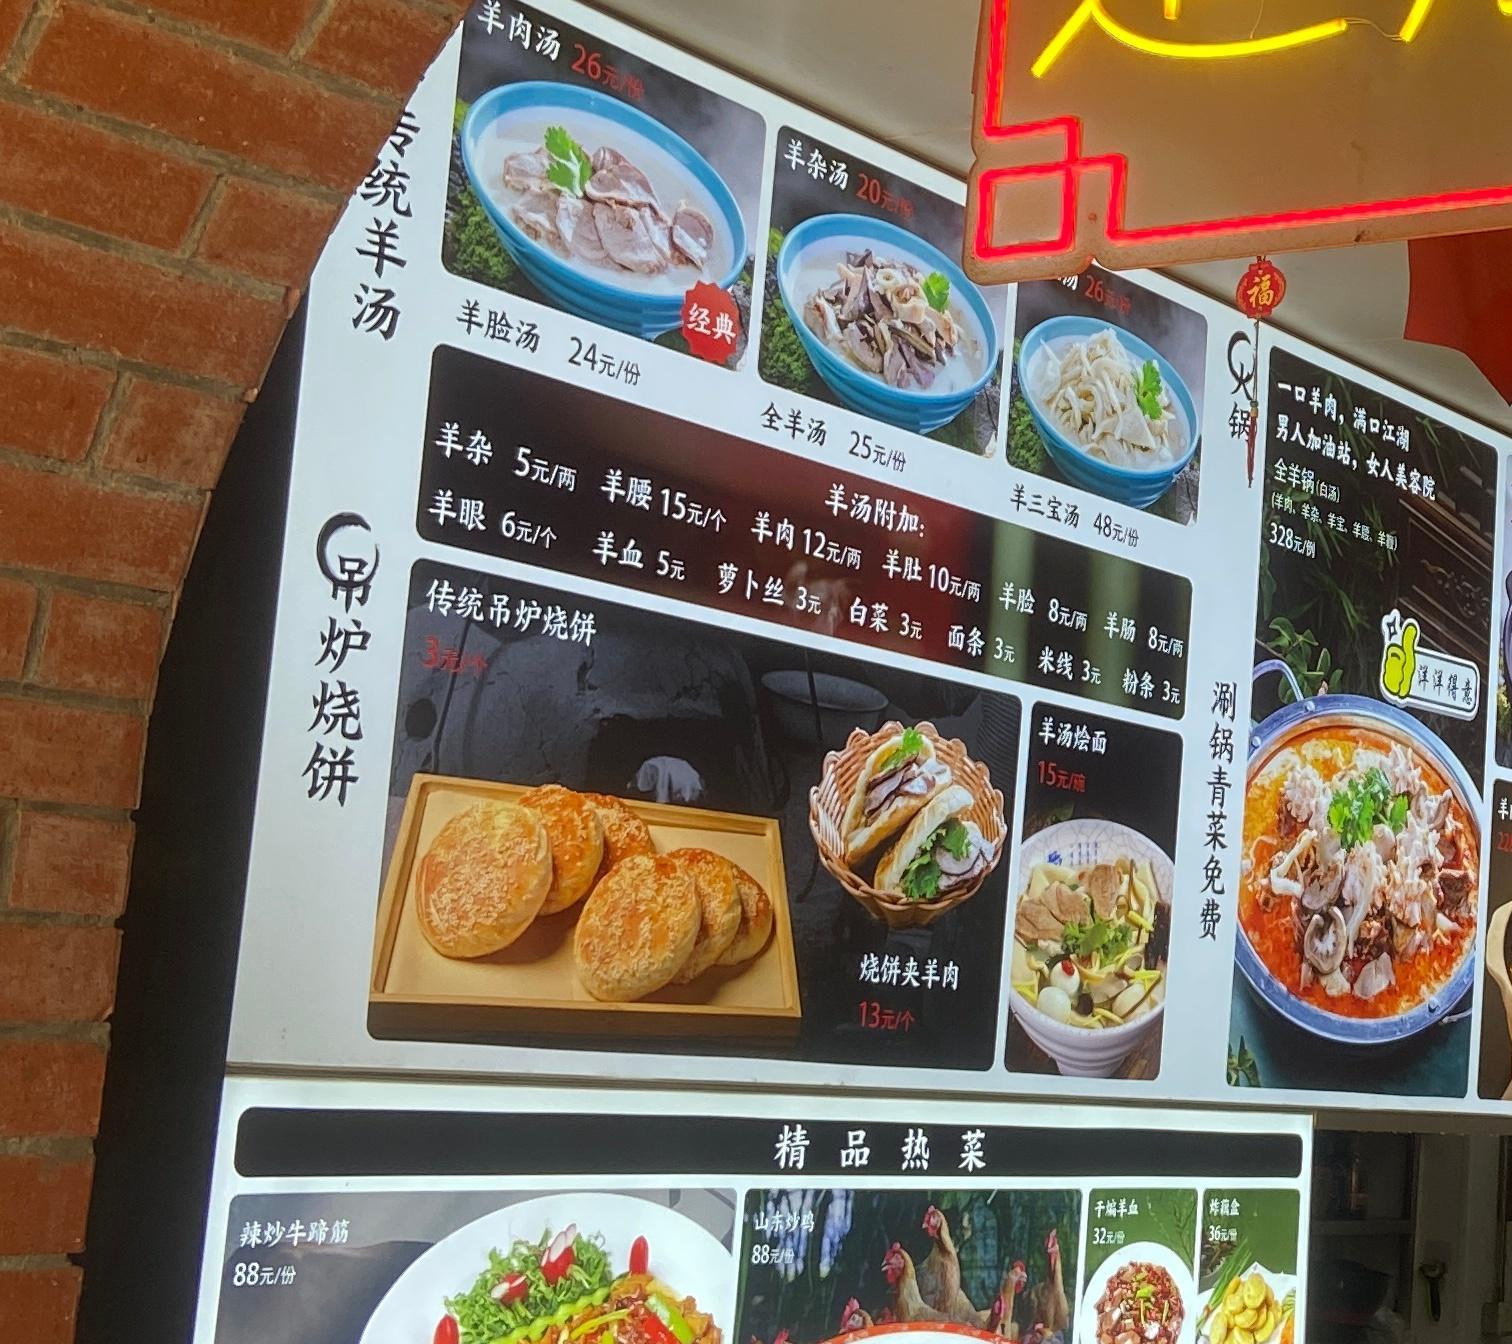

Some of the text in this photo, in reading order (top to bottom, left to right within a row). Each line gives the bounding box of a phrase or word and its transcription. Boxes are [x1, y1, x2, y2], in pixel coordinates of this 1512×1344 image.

[478, 0, 561, 61] 羊肉汤
[784, 140, 849, 191] 羊杂汤
[1247, 274, 1274, 307] 福
[457, 300, 641, 386] 羊脸汤 24元/份
[689, 304, 736, 346] 经典
[435, 423, 577, 492] 羊杂 5元/两
[761, 403, 907, 473] 全羊汤 25元/份
[429, 491, 557, 550] 羊眼 6元/个
[601, 469, 726, 533] 羊腰 15元/个
[1010, 486, 1139, 547] 羊三宝汤 48元/份
[593, 531, 685, 582] 羊血 5元
[751, 513, 861, 570] 羊肉 12元/两
[1270, 523, 1315, 558] 328元/例
[718, 563, 822, 615] 萝卜丝 3元
[883, 550, 982, 603] 羊肚 10元/两
[426, 579, 597, 646] 传统吊炉烧饼
[849, 597, 922, 640] 白菜 3元
[999, 584, 1087, 632] 羊脸 8元/两
[949, 625, 1015, 663] 面条 3元
[1104, 613, 1183, 657] 羊肠 8元/两
[301, 556, 373, 807] 吊炉烧饼
[1038, 650, 1101, 685] 米线 3元
[1122, 671, 1180, 705] 粉条 3元
[1038, 717, 1107, 755] 羊汤烩面
[1198, 682, 1237, 942] 涮锅青菜免费
[859, 953, 960, 990] 烧饼夹羊肉
[858, 1002, 914, 1032] 13元/个
[774, 1125, 987, 1171] 精品热菜
[240, 1220, 350, 1247] 辣炒牛蹄筋
[755, 1210, 814, 1232] 山东炒鸡
[1093, 1228, 1124, 1245] 32元/份
[1209, 1226, 1237, 1242] 36元/份
[233, 1261, 296, 1286] 88元/份
[752, 1244, 795, 1264] 88元/份
